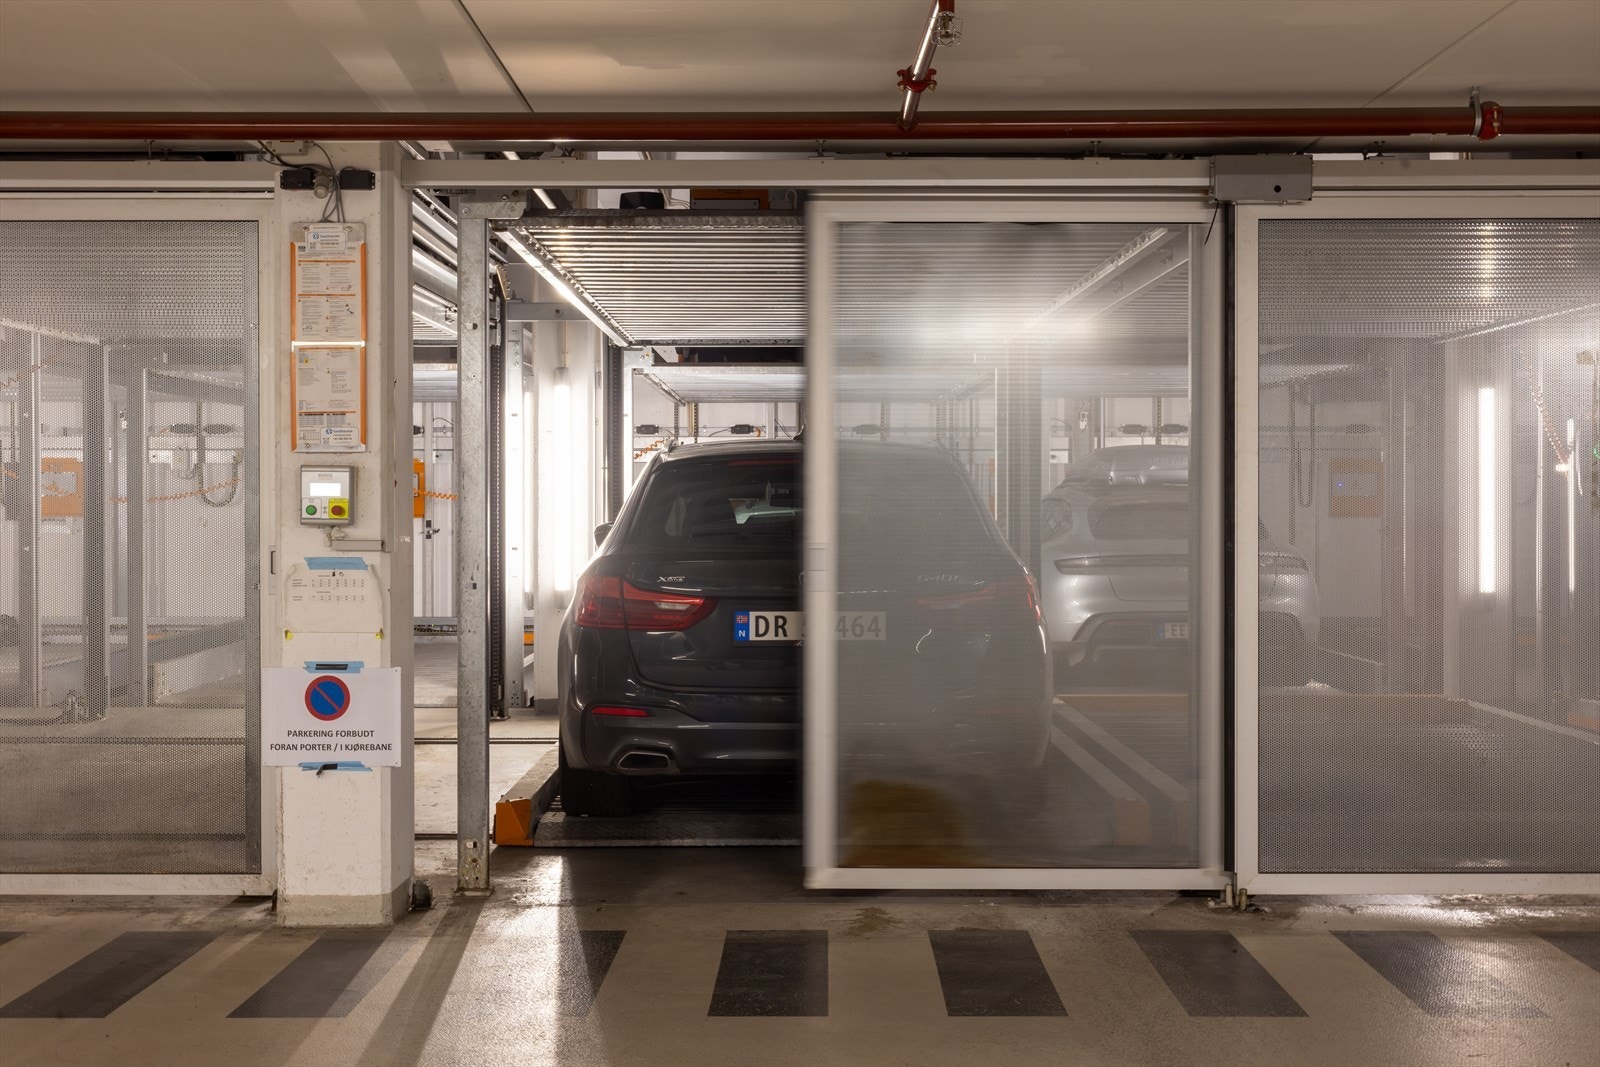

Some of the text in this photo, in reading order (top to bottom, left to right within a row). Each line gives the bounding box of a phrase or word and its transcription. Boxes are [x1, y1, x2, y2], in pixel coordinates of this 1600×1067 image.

[754, 614, 788, 638] DR
[738, 630, 746, 638] N
[287, 730, 375, 738] PARKERING FORBUDT
[270, 743, 298, 751] FORAN
[300, 743, 332, 751] PORTER
[333, 743, 338, 752] /
[344, 743, 393, 751] KJØREBANE
